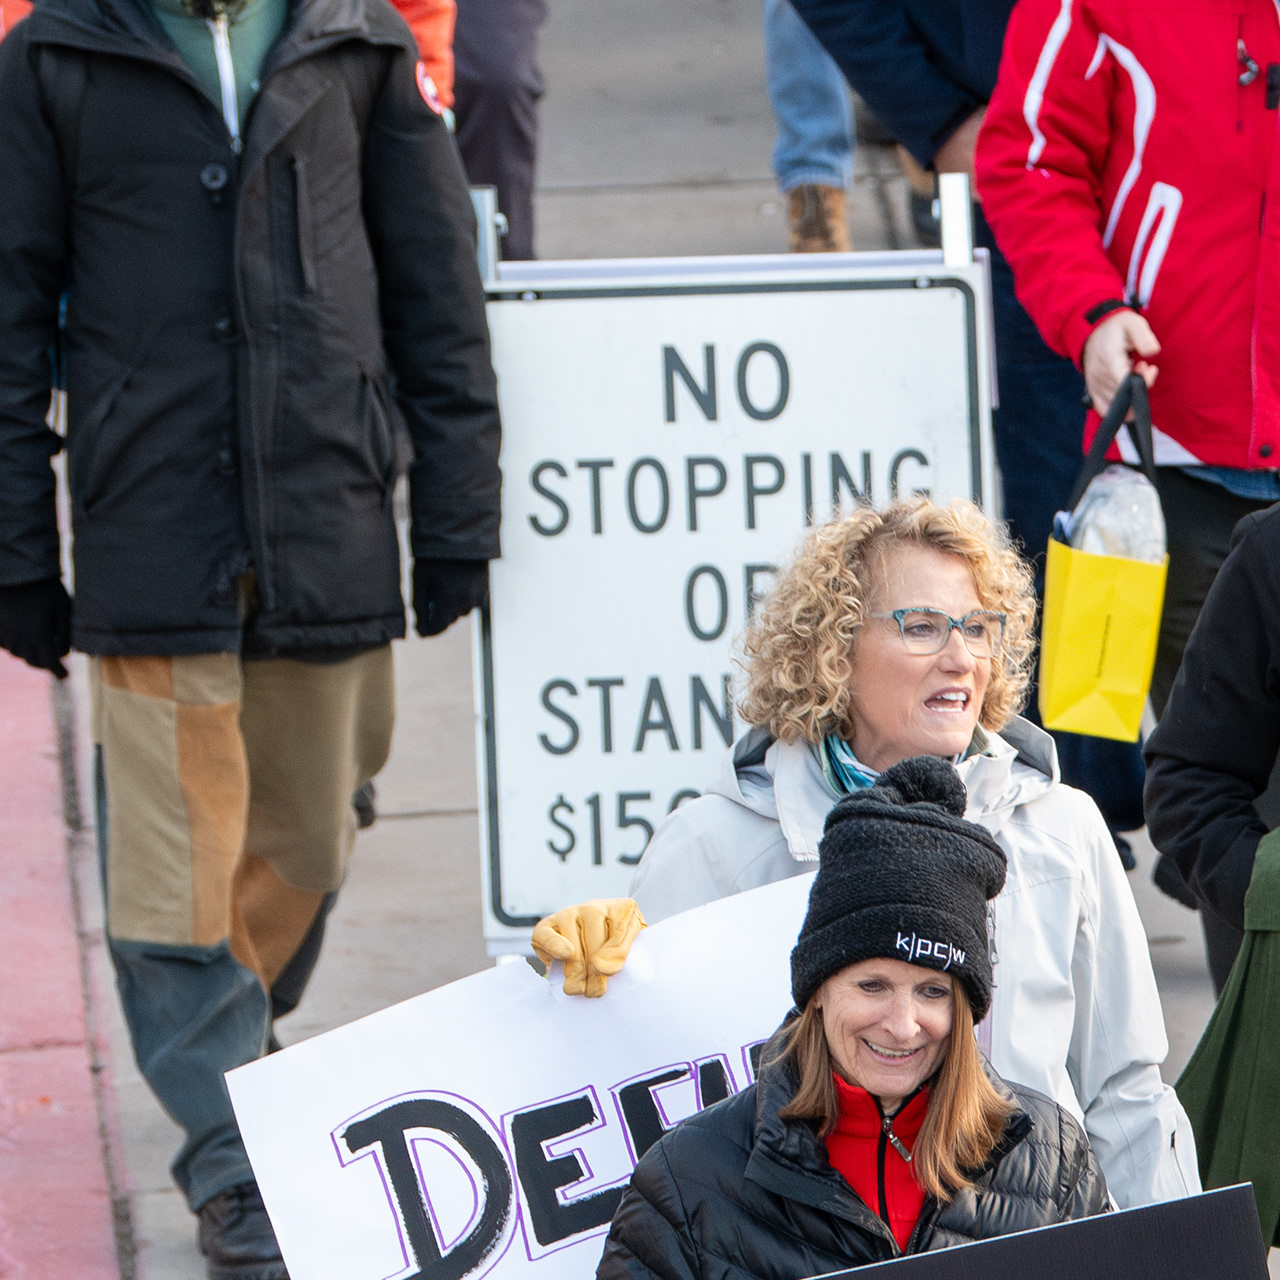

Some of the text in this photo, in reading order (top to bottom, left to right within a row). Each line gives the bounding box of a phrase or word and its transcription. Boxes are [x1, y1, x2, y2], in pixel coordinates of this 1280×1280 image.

[662, 340, 791, 423] NO
[538, 674, 736, 756] STAN
[546, 789, 702, 867] $15
